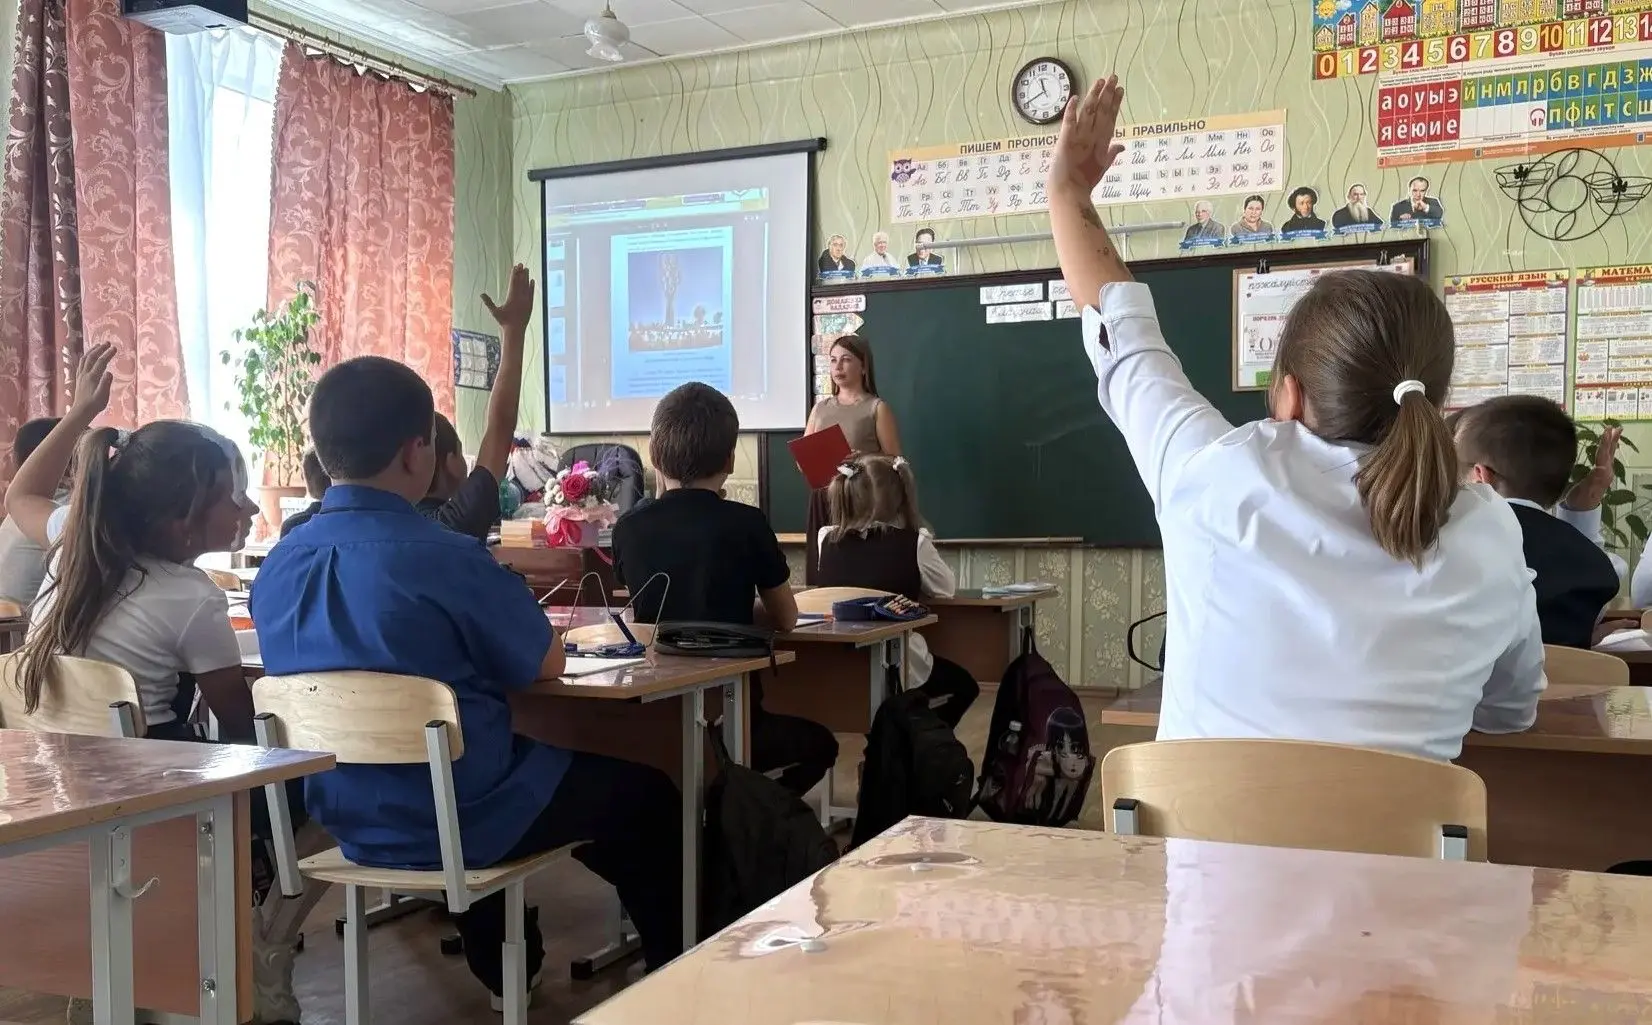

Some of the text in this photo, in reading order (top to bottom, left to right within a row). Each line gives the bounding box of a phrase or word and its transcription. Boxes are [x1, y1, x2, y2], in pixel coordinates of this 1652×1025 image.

[1319, 54, 1335, 76] 0
[1342, 51, 1353, 74] 1
[1362, 49, 1377, 72] 2
[1383, 46, 1398, 70] 3
[1403, 43, 1420, 66] 4
[1428, 40, 1444, 63] 5
[1451, 37, 1466, 61] 6
[1475, 34, 1490, 58] 7
[1497, 30, 1514, 54] 8
[1520, 27, 1538, 51] 9
[1540, 25, 1562, 48] 10
[1567, 22, 1586, 46] 11
[1590, 19, 1612, 44] 12
[1614, 16, 1638, 41] 13
[1464, 67, 1652, 100] й н м л р б в г д з ж
[1381, 88, 1458, 112] а о у ы э
[1550, 108, 1560, 124] п
[1566, 102, 1580, 127] ф
[1585, 104, 1596, 120] к
[1604, 103, 1614, 118] т
[1622, 101, 1632, 116] с
[960, 141, 1001, 154] ПИШЕМ
[1008, 134, 1060, 148] ПРОПИСН
[1132, 120, 1206, 136] ПРАВИЛЬНО
[1381, 118, 1458, 140] я ё ю и е
[1518, 272, 1547, 280] ЯЗЫК
[1602, 266, 1652, 276] МАТЕМА
